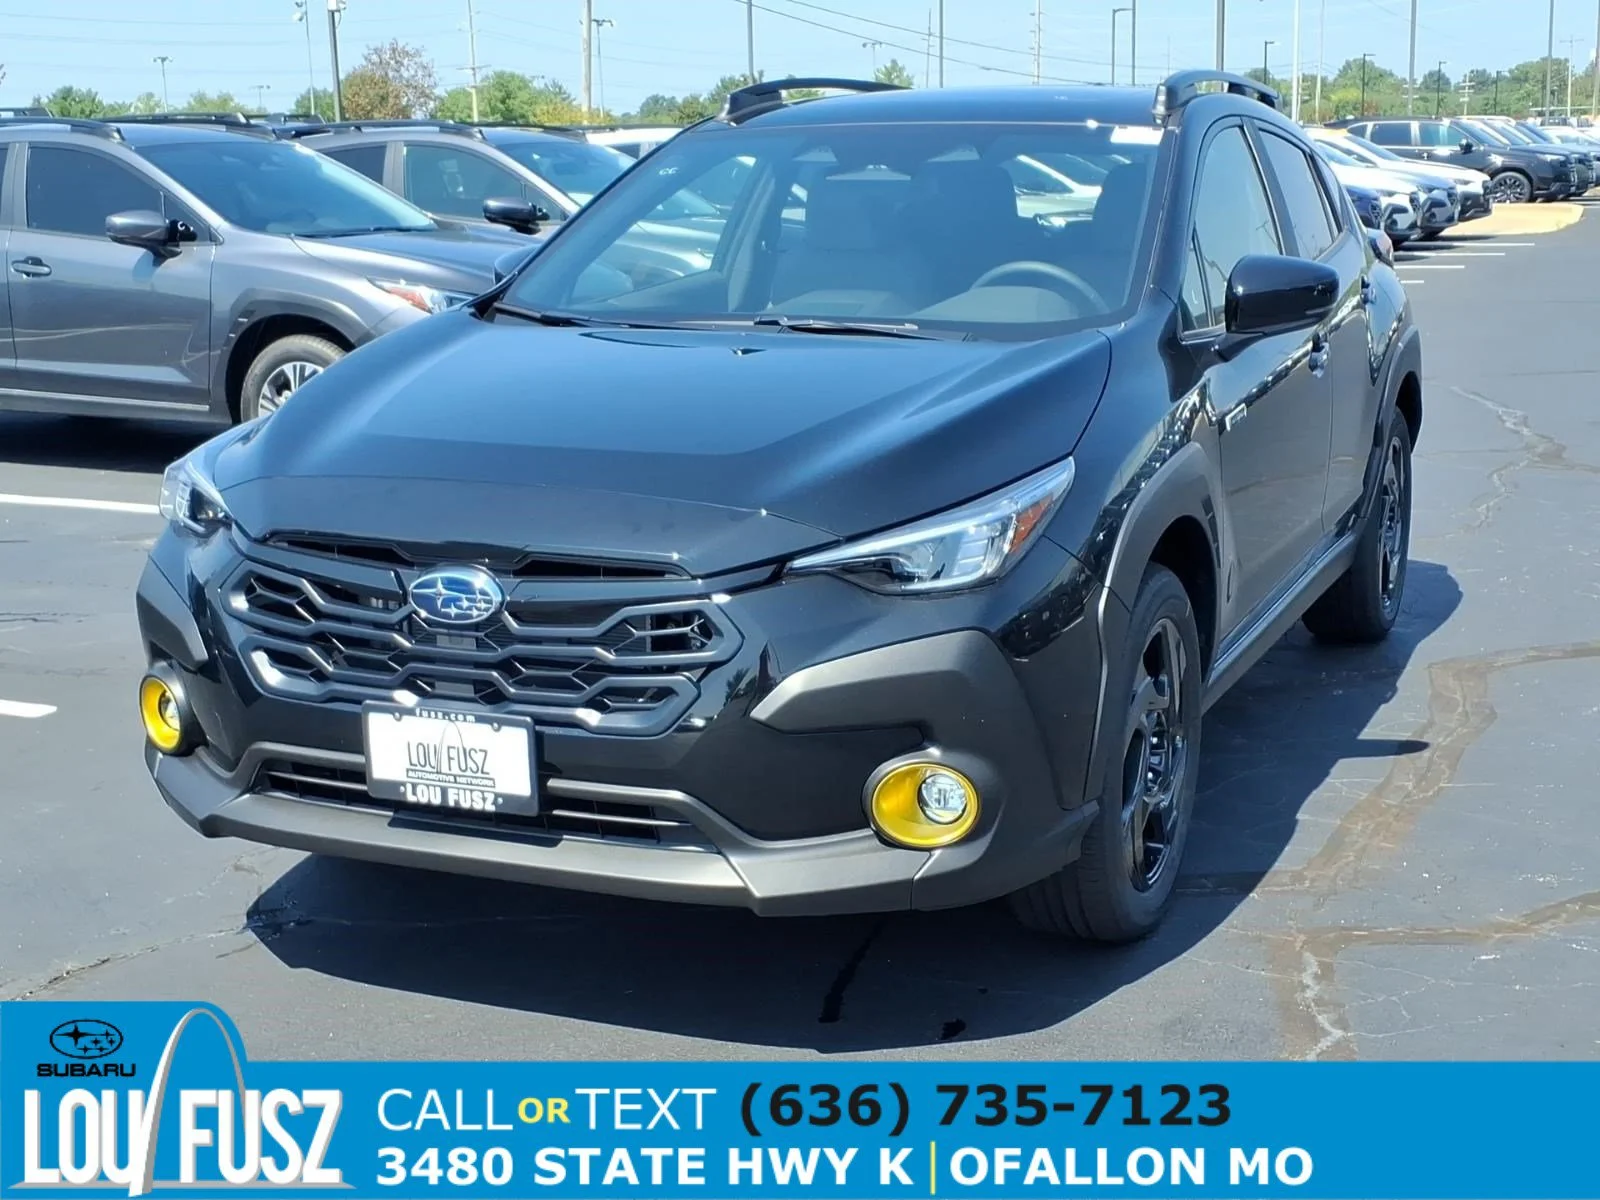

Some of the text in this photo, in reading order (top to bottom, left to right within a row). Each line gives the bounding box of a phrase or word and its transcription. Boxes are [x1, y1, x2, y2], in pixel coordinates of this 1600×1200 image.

[415, 708, 476, 722] fusz.com
[407, 741, 490, 775] LOU FUSZ
[408, 770, 495, 787] AUTOMOTIVE NETWORK
[406, 783, 496, 811] LOU FUSZ
